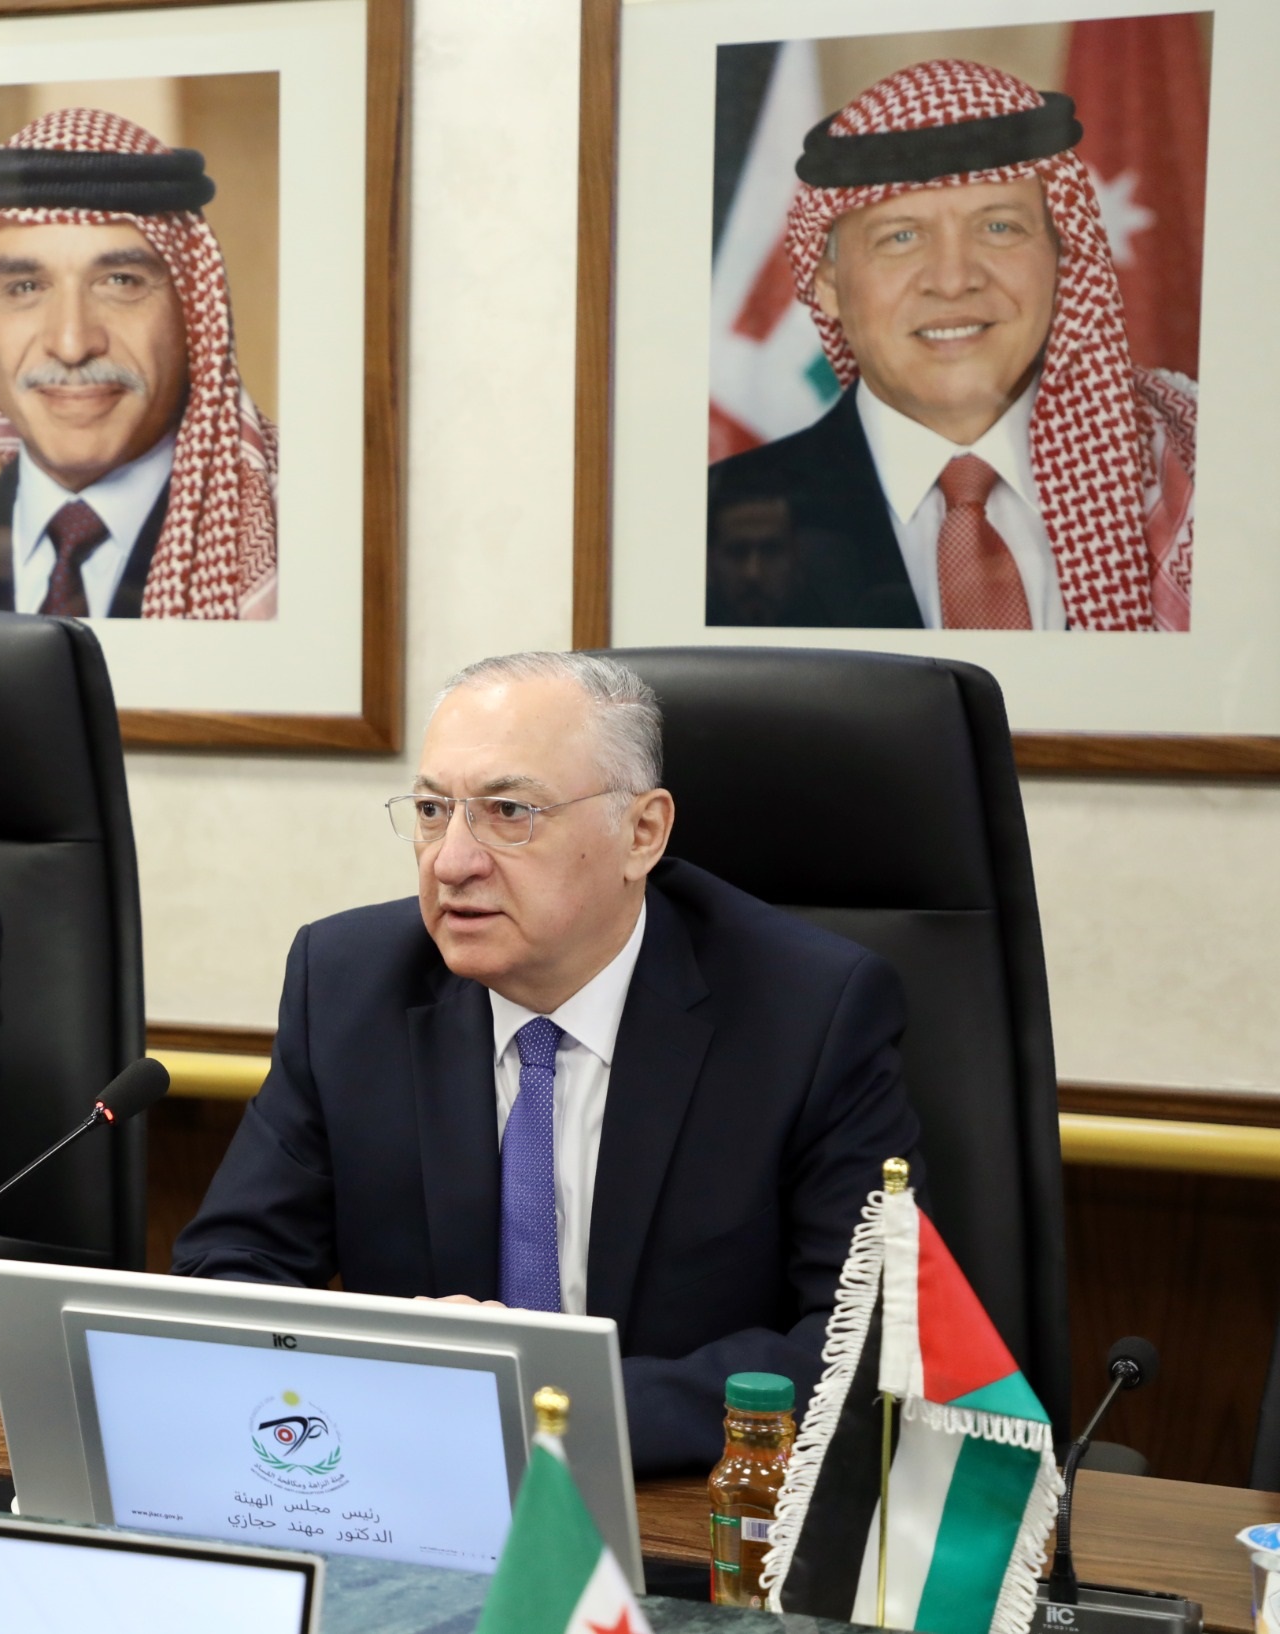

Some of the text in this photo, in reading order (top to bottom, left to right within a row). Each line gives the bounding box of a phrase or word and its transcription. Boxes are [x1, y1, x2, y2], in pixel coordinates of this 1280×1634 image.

[234, 1491, 273, 1508] الهيئة
[284, 1499, 331, 1515] مجلس
[341, 1508, 380, 1523] رئيس
[227, 1512, 393, 1544] الدكتور مهند حجازي
